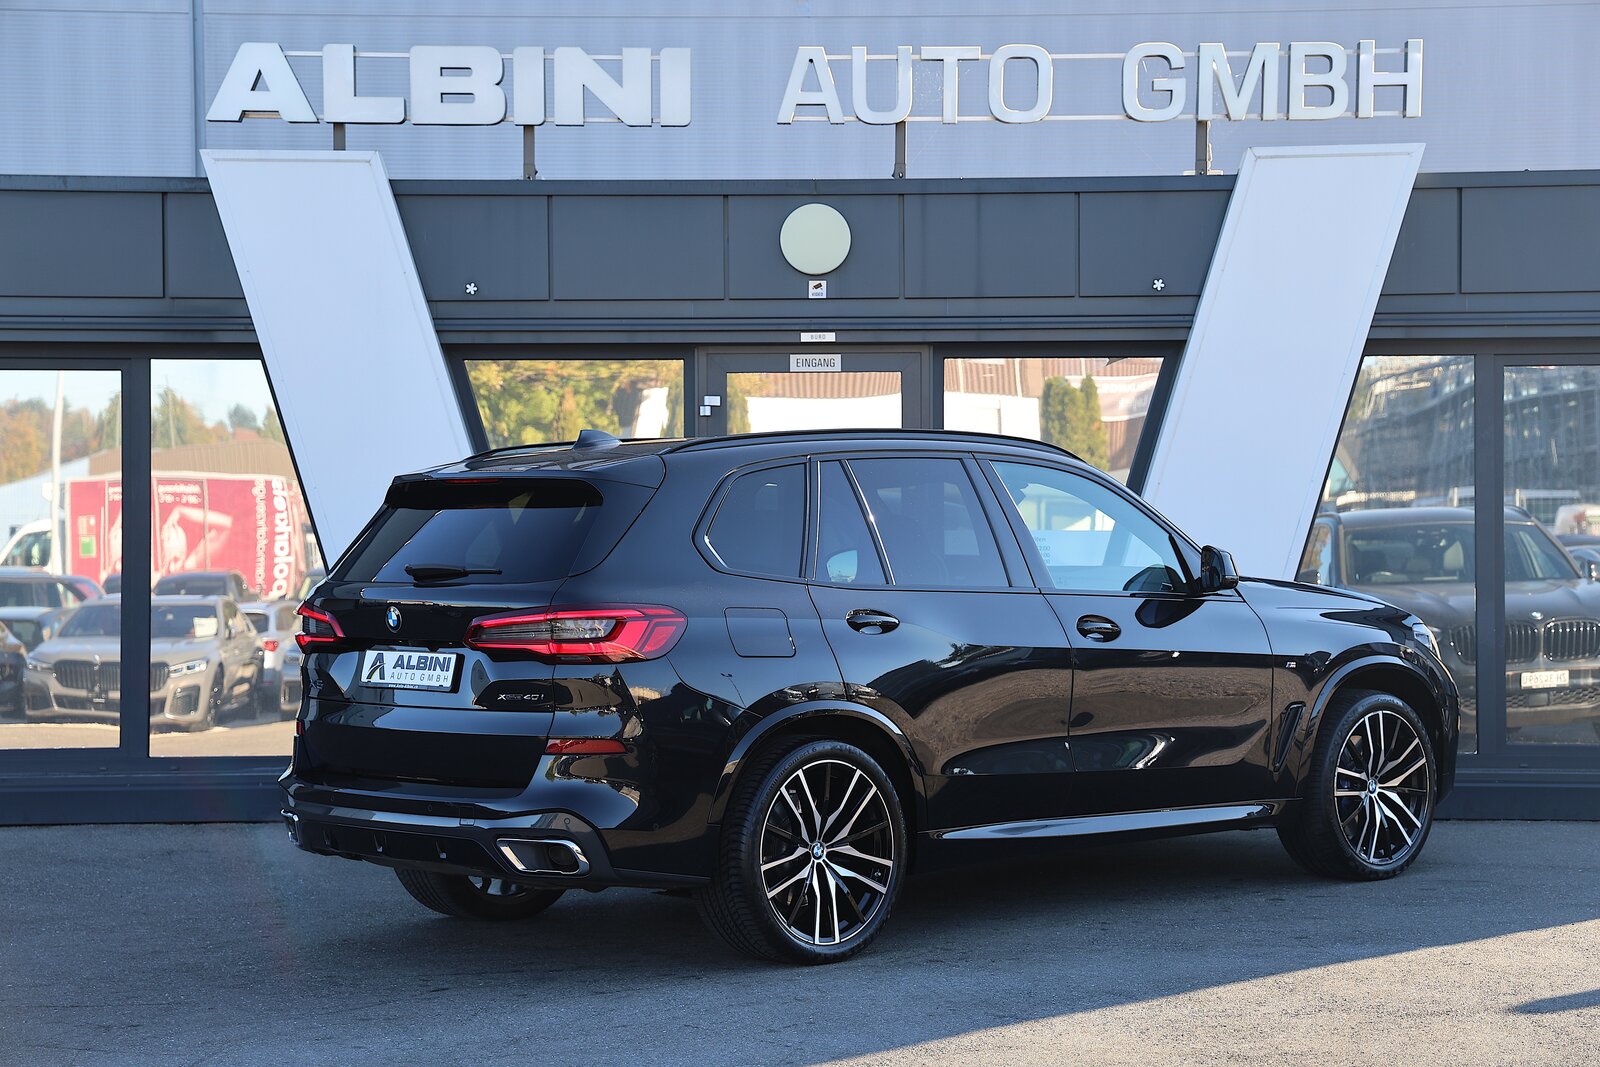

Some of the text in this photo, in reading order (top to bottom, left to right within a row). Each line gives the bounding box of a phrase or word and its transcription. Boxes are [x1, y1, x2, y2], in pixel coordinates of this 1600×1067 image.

[206, 38, 1424, 127] ALBINI AUTO GMBH
[796, 358, 835, 367] EINGANG
[393, 654, 452, 672] ALBINI
[390, 672, 449, 682] AUTO GMBH
